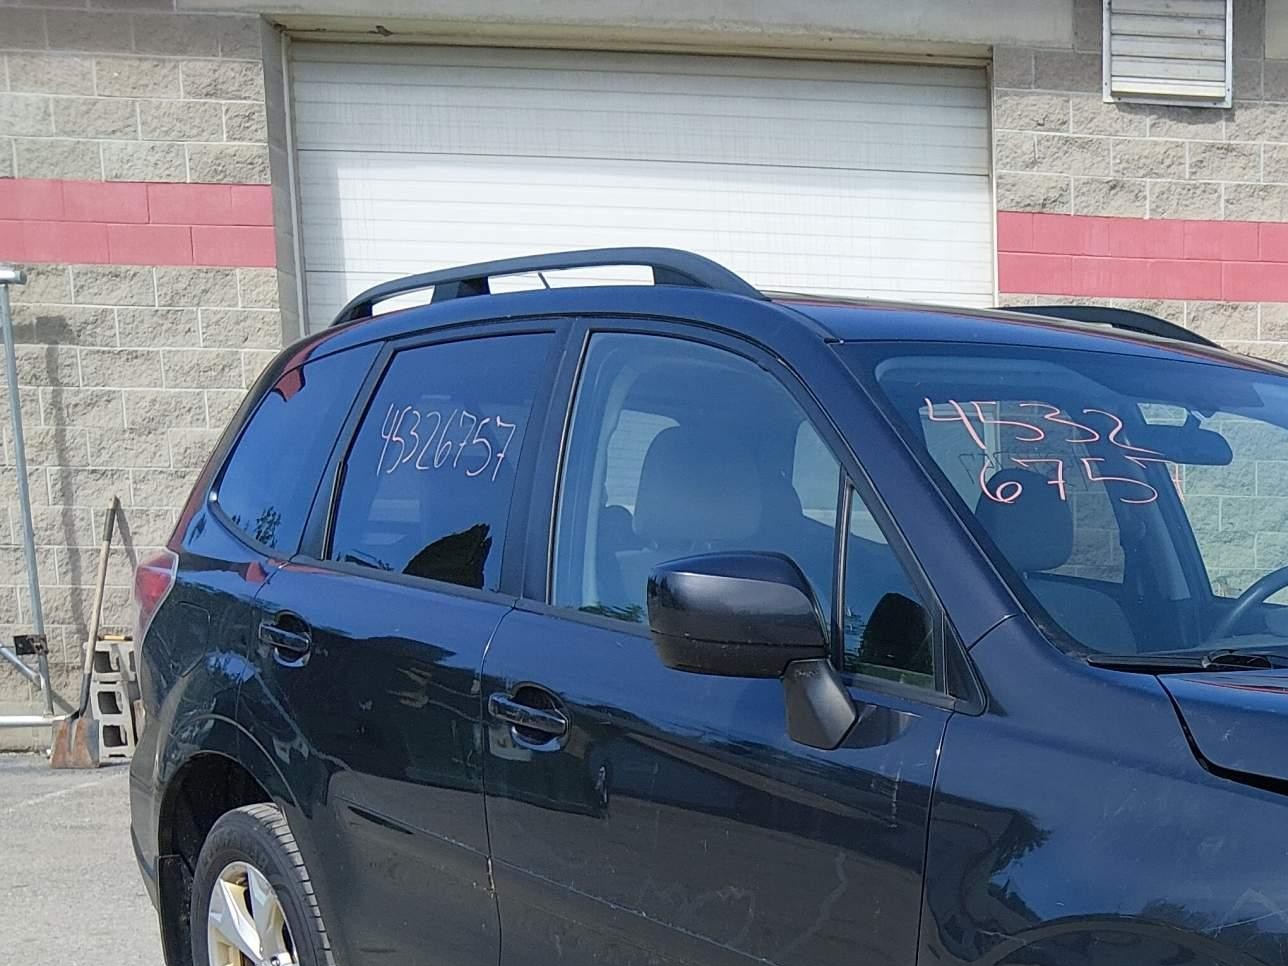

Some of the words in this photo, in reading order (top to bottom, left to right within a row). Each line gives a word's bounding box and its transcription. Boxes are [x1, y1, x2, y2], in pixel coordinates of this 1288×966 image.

[377, 403, 516, 482] 45326757
[924, 398, 1164, 455] 4532
[979, 454, 1186, 503] 6757
